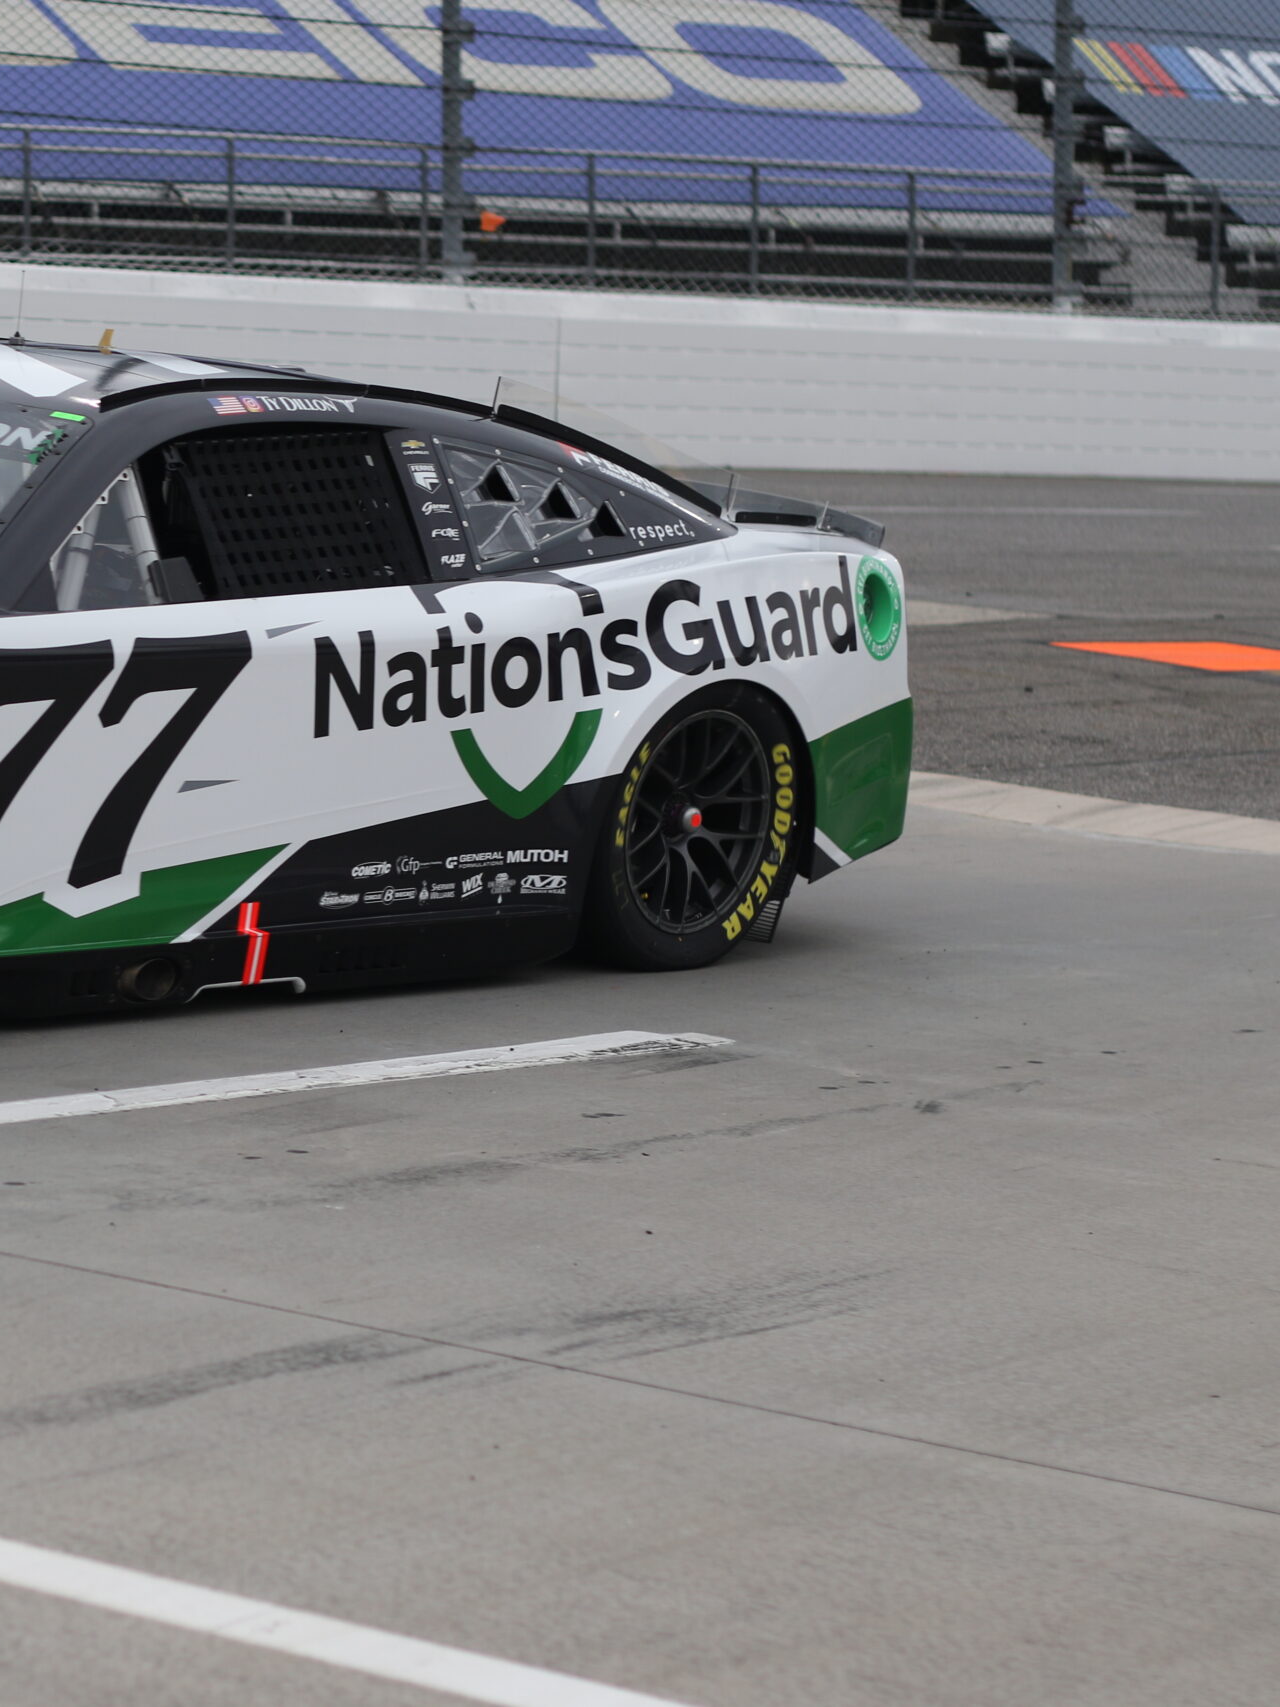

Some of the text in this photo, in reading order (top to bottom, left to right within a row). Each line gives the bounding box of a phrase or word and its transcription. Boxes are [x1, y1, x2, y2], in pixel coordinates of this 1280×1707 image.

[256, 395, 339, 412] TY DILLON
[459, 851, 505, 863] GENERAL
[506, 849, 569, 864] MUTOH
[461, 872, 484, 894] WIX
